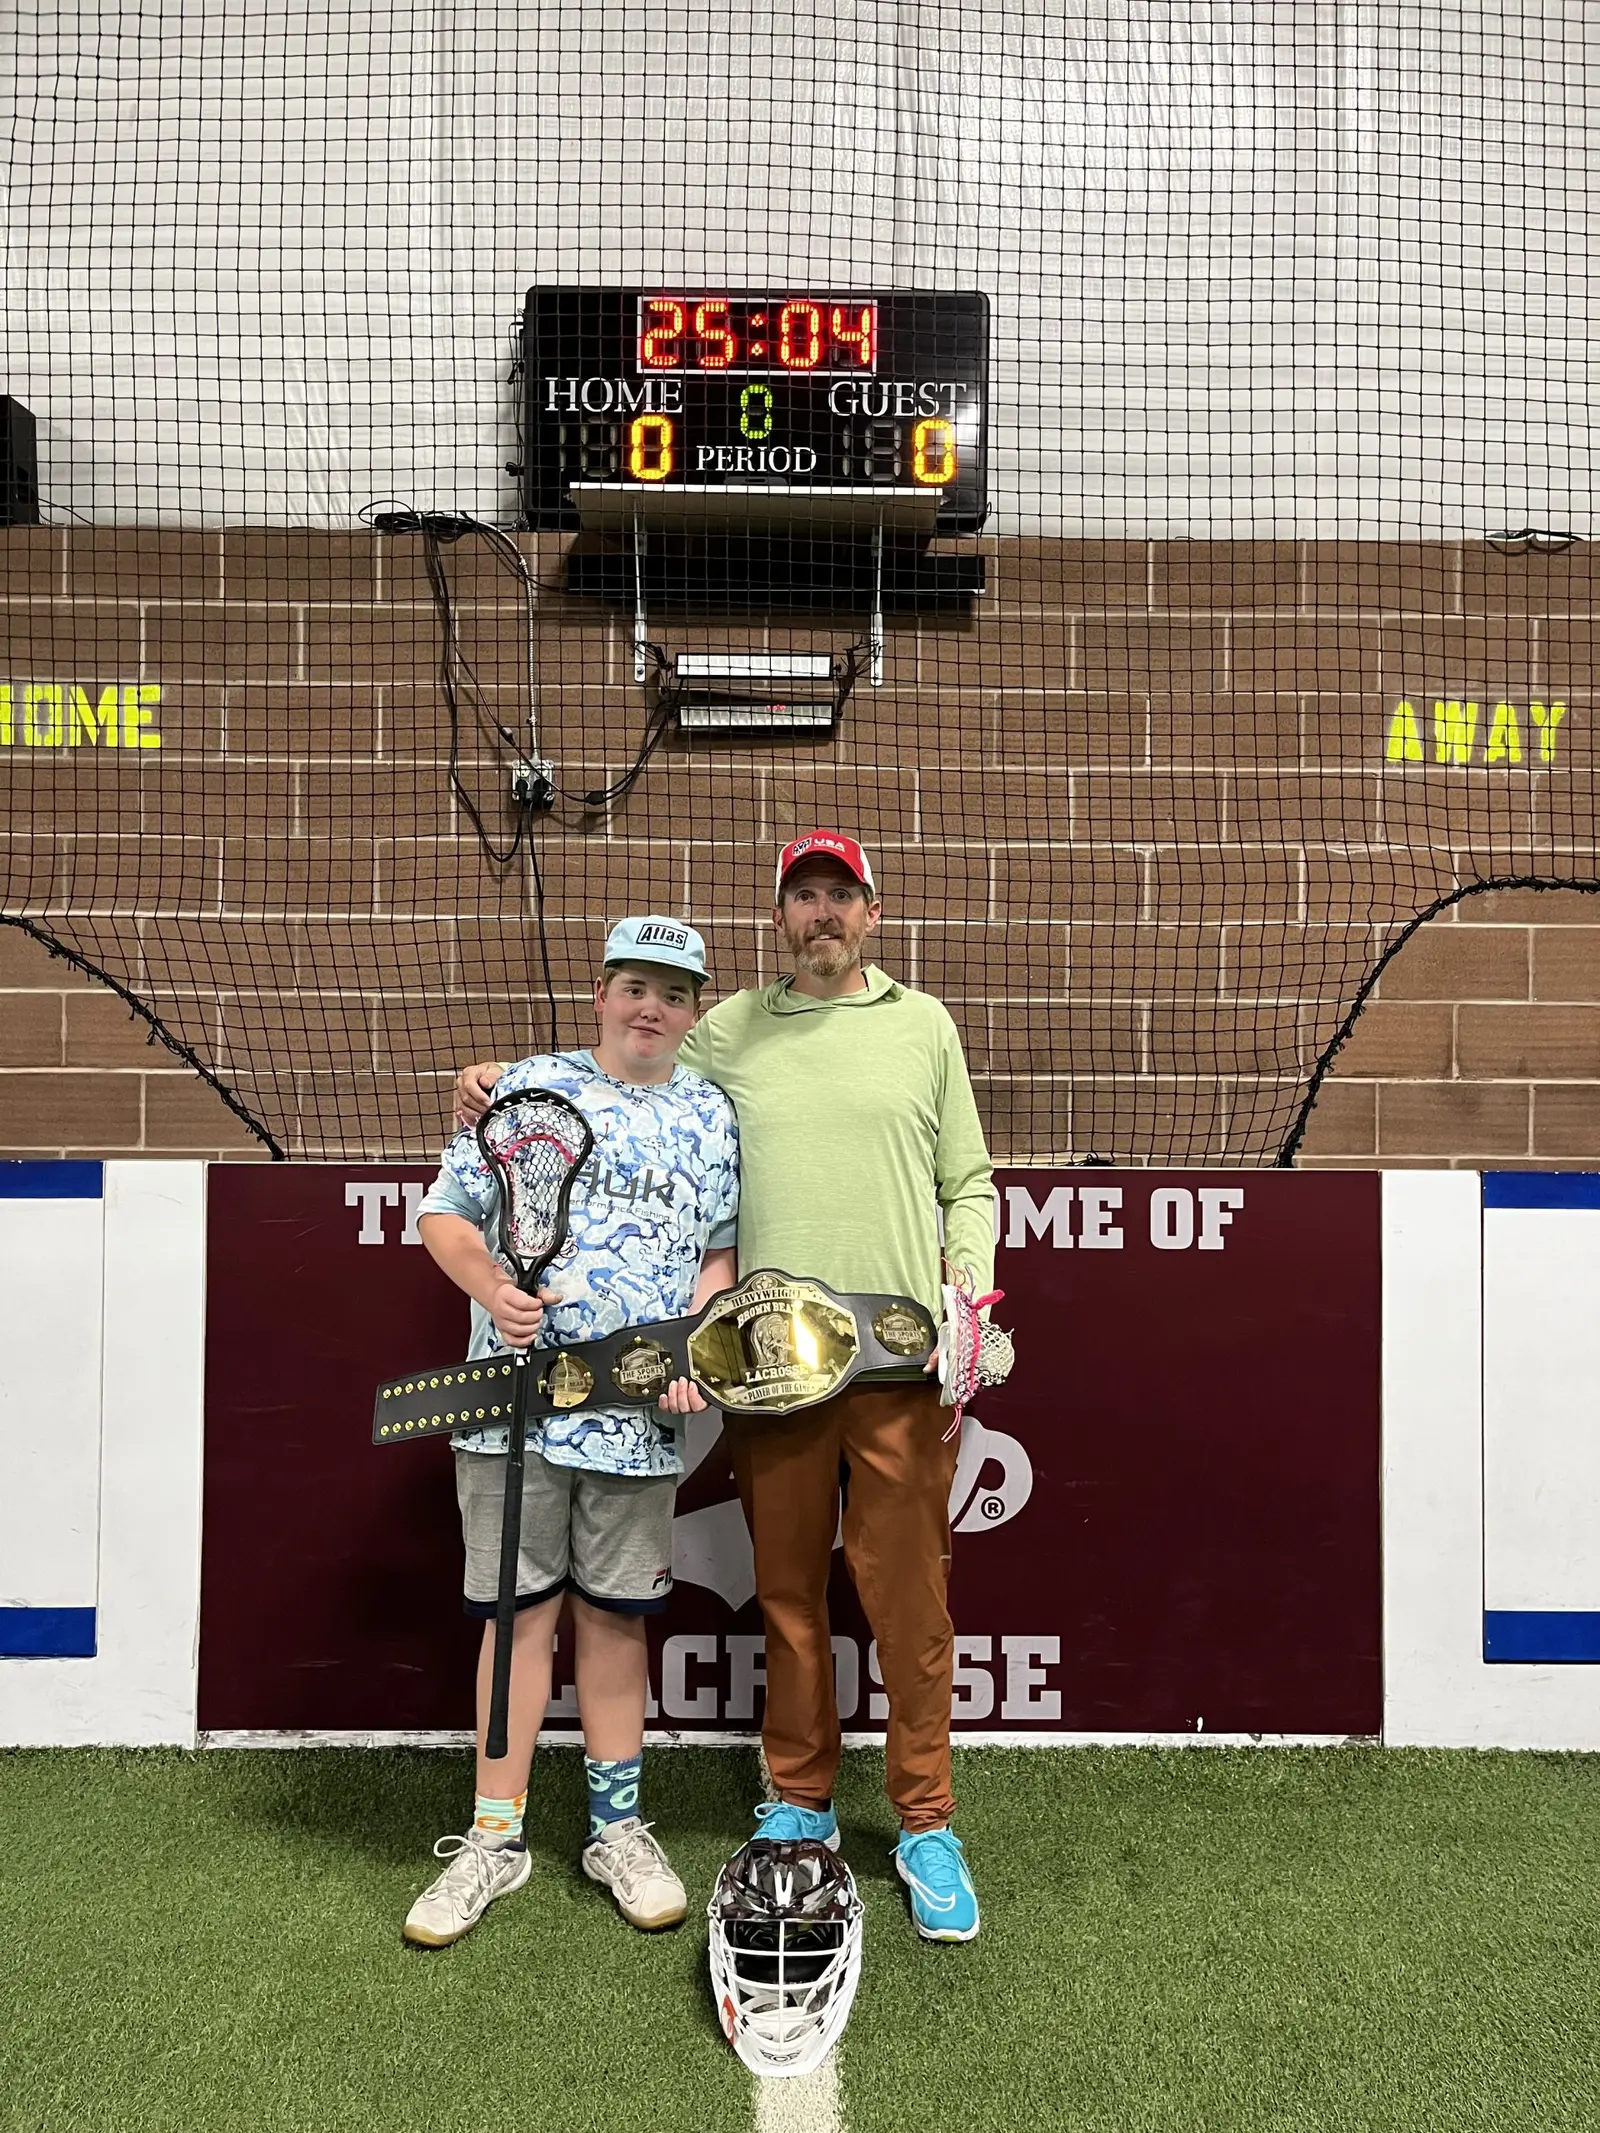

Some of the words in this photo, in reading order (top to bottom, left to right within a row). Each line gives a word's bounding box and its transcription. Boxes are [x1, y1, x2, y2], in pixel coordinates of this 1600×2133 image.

[643, 301, 871, 368] 25:04
[544, 377, 683, 413] HOME
[739, 383, 773, 440] 0
[828, 381, 967, 418] GUEST
[630, 414, 674, 481] 0
[696, 445, 817, 473] PERIOD
[912, 418, 955, 484] 0
[1386, 701, 1567, 763] AWAY
[640, 926, 684, 945] Atlas
[570, 1199, 632, 1213] erformance
[1150, 1187, 1244, 1250] OF
[736, 1302, 771, 1329] BROWN
[771, 1302, 798, 1314] BEA
[622, 1371, 635, 1380] THE
[637, 1366, 664, 1376] SPORTS
[745, 1364, 809, 1383] LACROSSE
[747, 1387, 771, 1401] PLAYER
[771, 1385, 779, 1395] OF
[781, 1384, 792, 1394] THE
